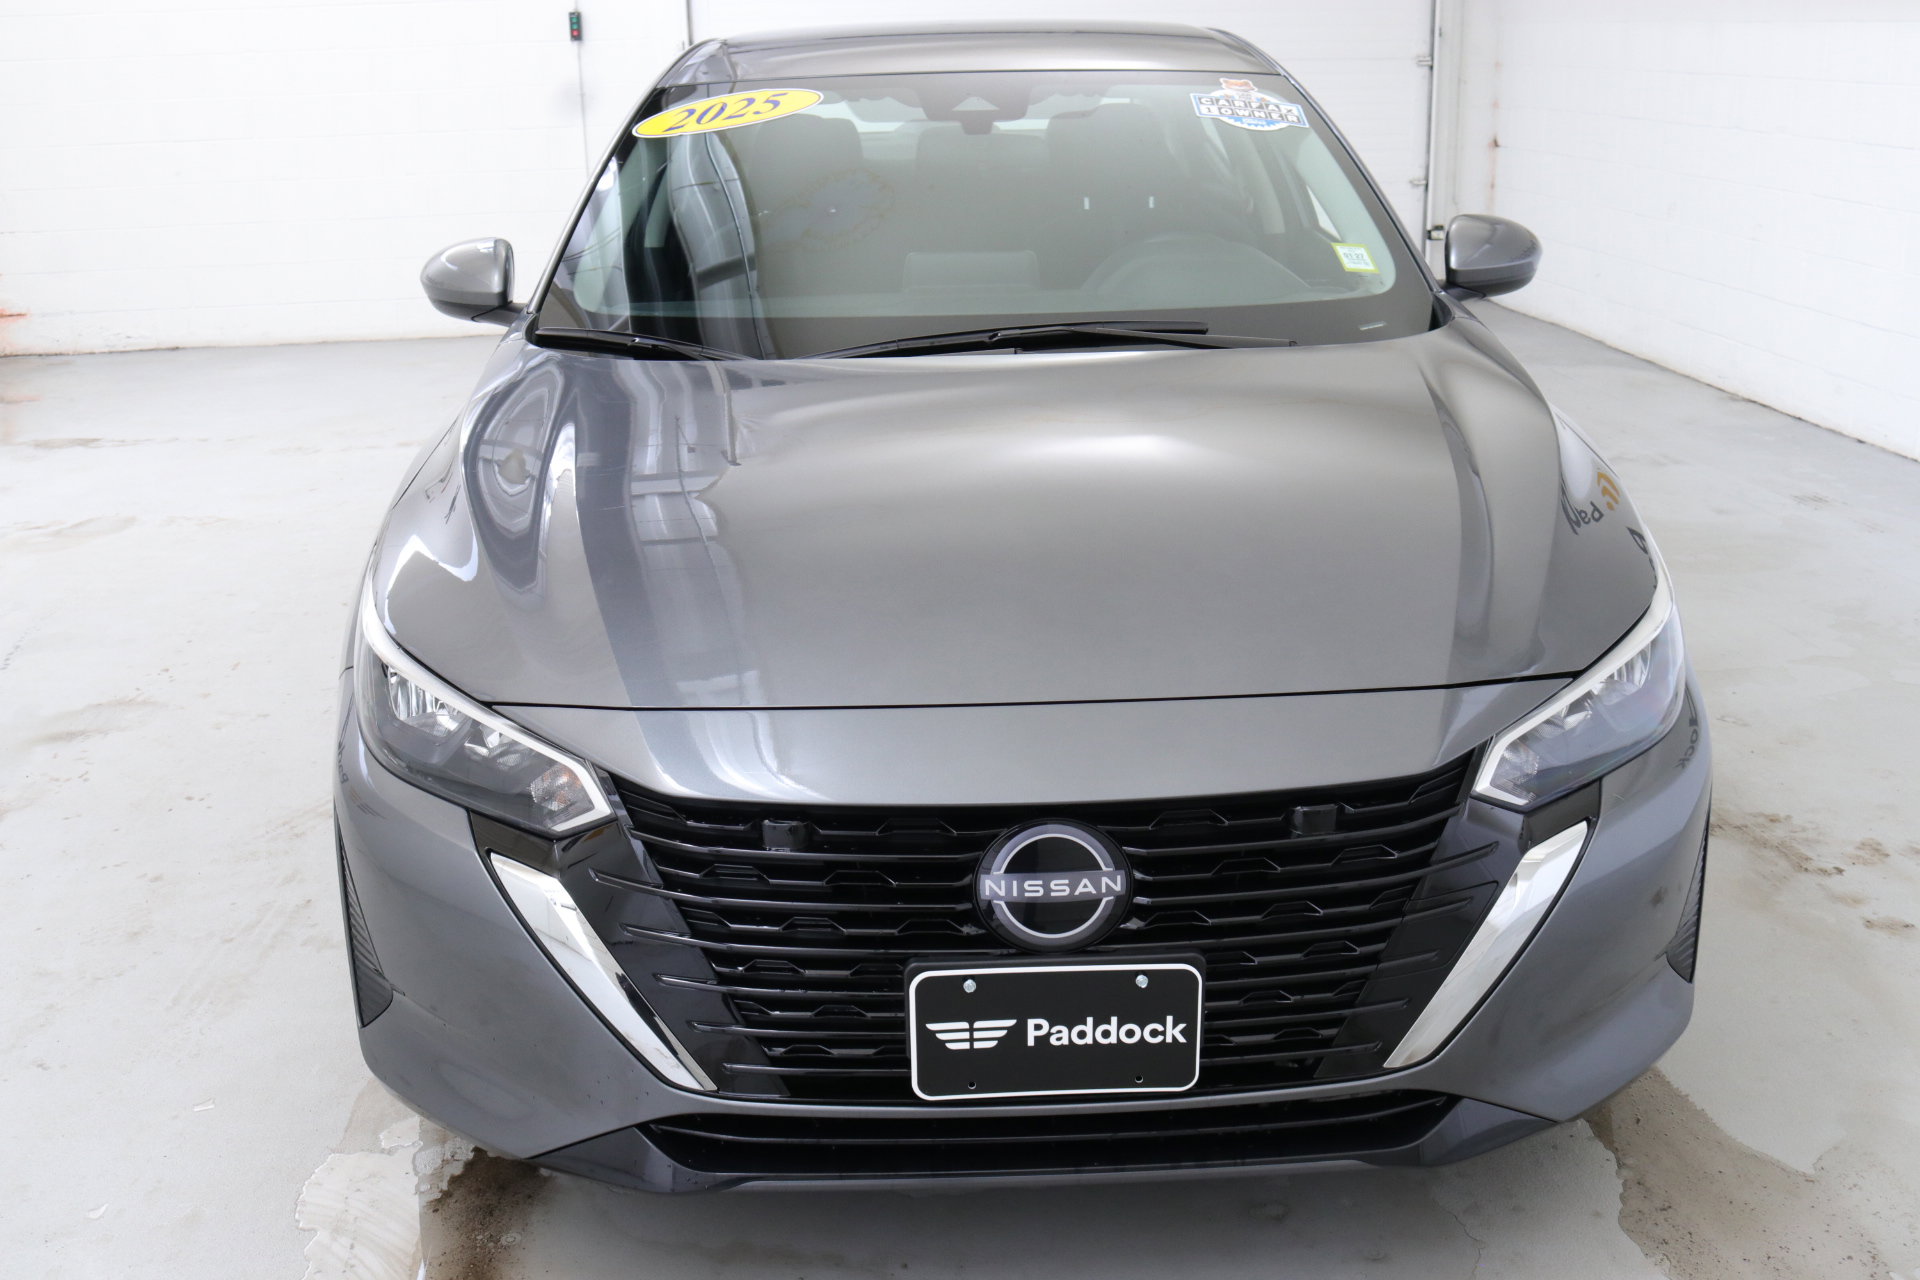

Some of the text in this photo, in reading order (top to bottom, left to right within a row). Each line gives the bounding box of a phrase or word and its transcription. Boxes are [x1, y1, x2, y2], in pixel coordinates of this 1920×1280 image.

[661, 92, 789, 132] 2025
[1199, 97, 1295, 115] CARFAX
[1219, 107, 1300, 122] OWNER
[984, 874, 1122, 897] NISSAN
[1027, 1015, 1188, 1047] Paddock
